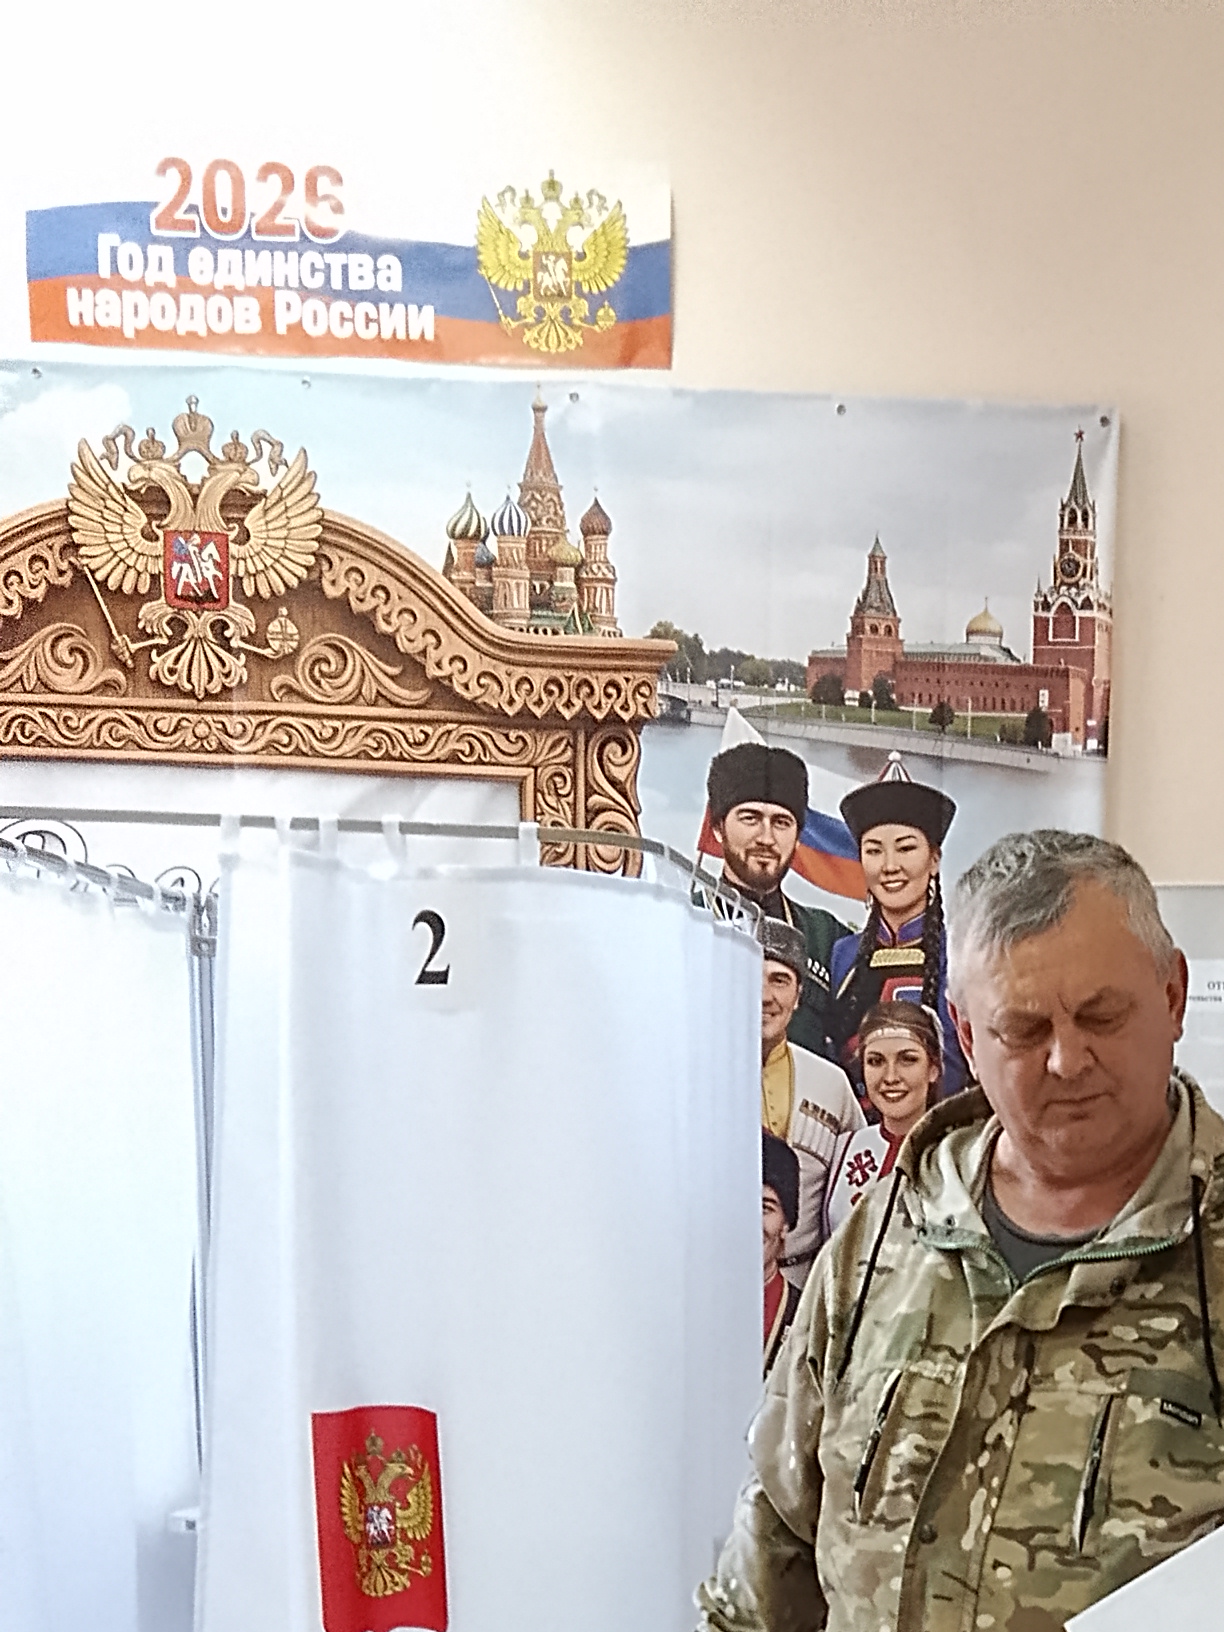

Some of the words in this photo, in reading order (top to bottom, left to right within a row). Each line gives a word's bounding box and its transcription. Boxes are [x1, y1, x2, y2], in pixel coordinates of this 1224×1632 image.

[154, 156, 346, 240] 2026
[97, 233, 176, 287] Год
[187, 243, 403, 292] единства
[66, 287, 262, 338] народов
[271, 290, 436, 340] России
[411, 908, 451, 986] 2
